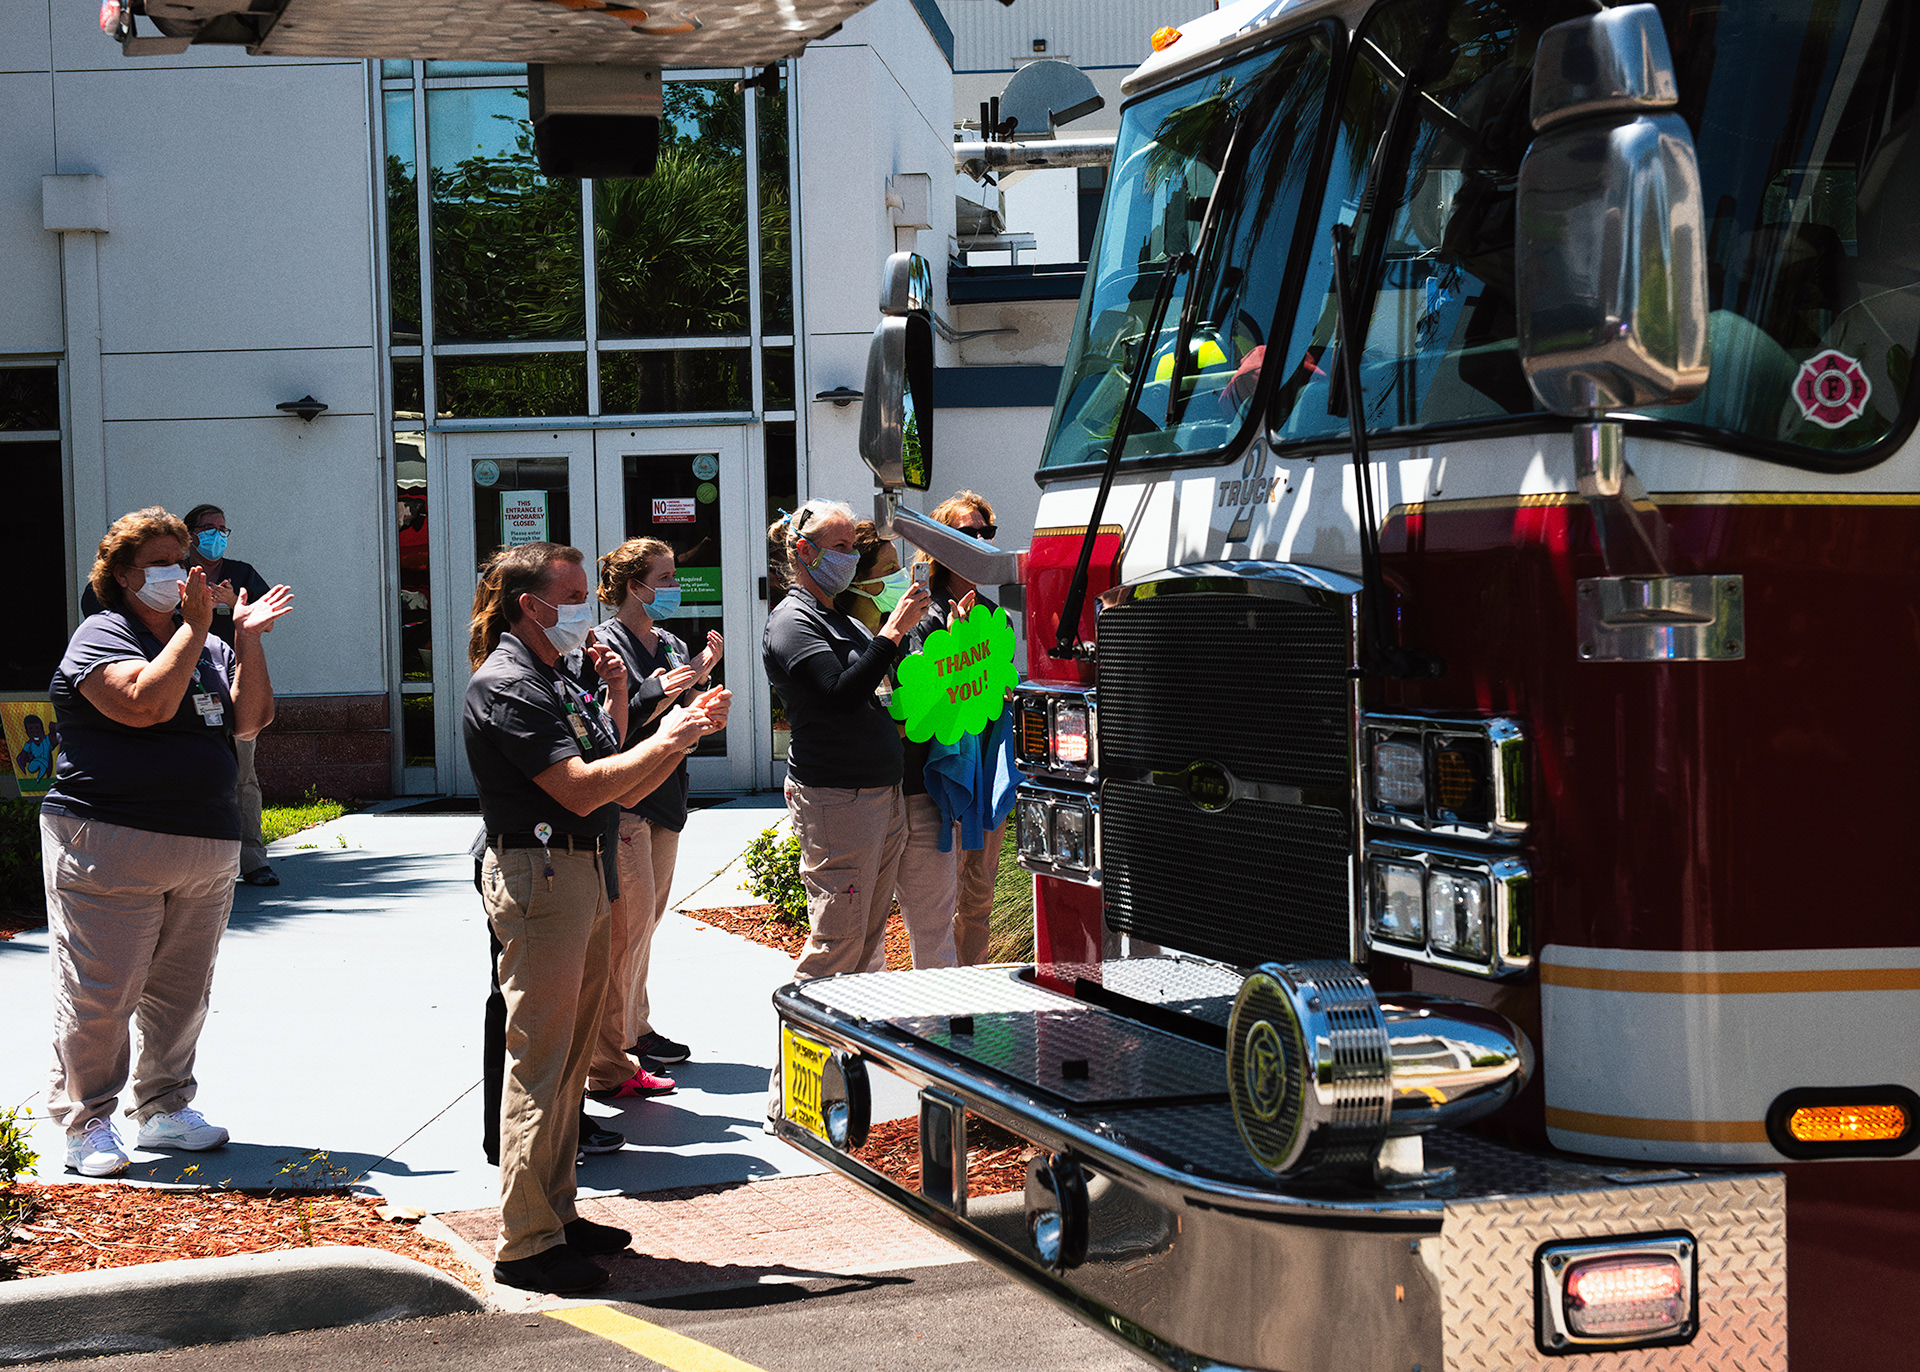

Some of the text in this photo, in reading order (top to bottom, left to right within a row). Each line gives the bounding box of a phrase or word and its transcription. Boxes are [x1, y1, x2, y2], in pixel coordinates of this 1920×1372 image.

[654, 500, 667, 515] NO
[1218, 477, 1280, 508] TRUCK
[934, 639, 991, 677] THANK
[946, 669, 988, 704] YOU!
